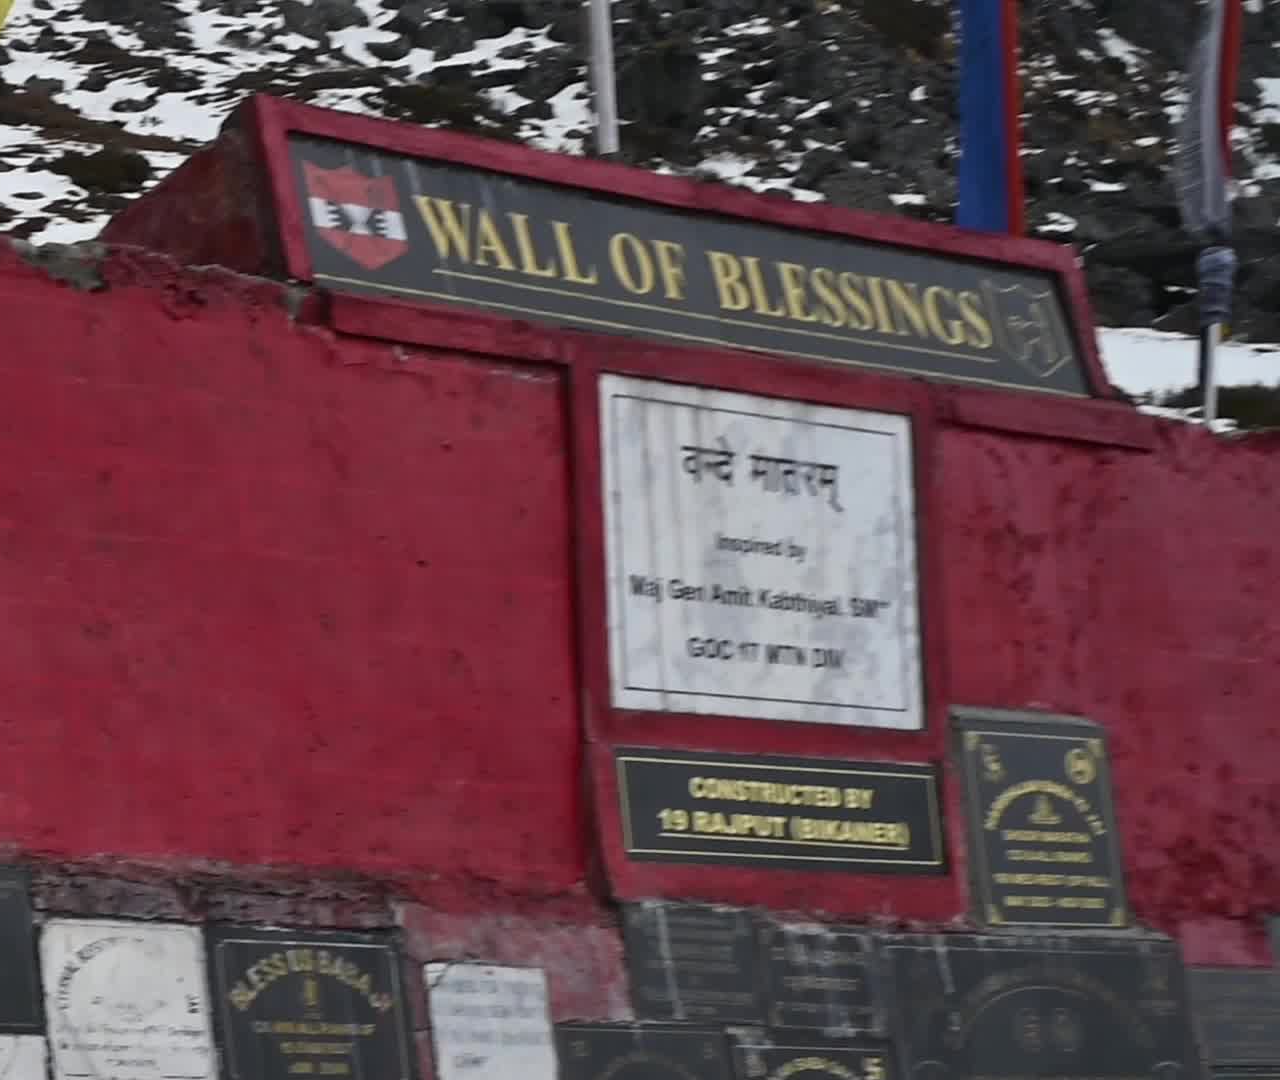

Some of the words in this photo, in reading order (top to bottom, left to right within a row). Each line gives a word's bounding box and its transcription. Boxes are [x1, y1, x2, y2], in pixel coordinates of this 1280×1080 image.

[414, 194, 598, 286] WALL
[608, 231, 687, 300] OF
[705, 249, 993, 350] BLESSINGS
[786, 542, 807, 563] by
[629, 573, 662, 603] Maj
[667, 577, 707, 602] Gen
[711, 582, 754, 607] Amit
[687, 637, 735, 662] GOC
[688, 776, 840, 808] CONSTRUCTED
[842, 786, 875, 810] BY
[657, 809, 688, 831] 19
[691, 811, 788, 840] RAJPUT
